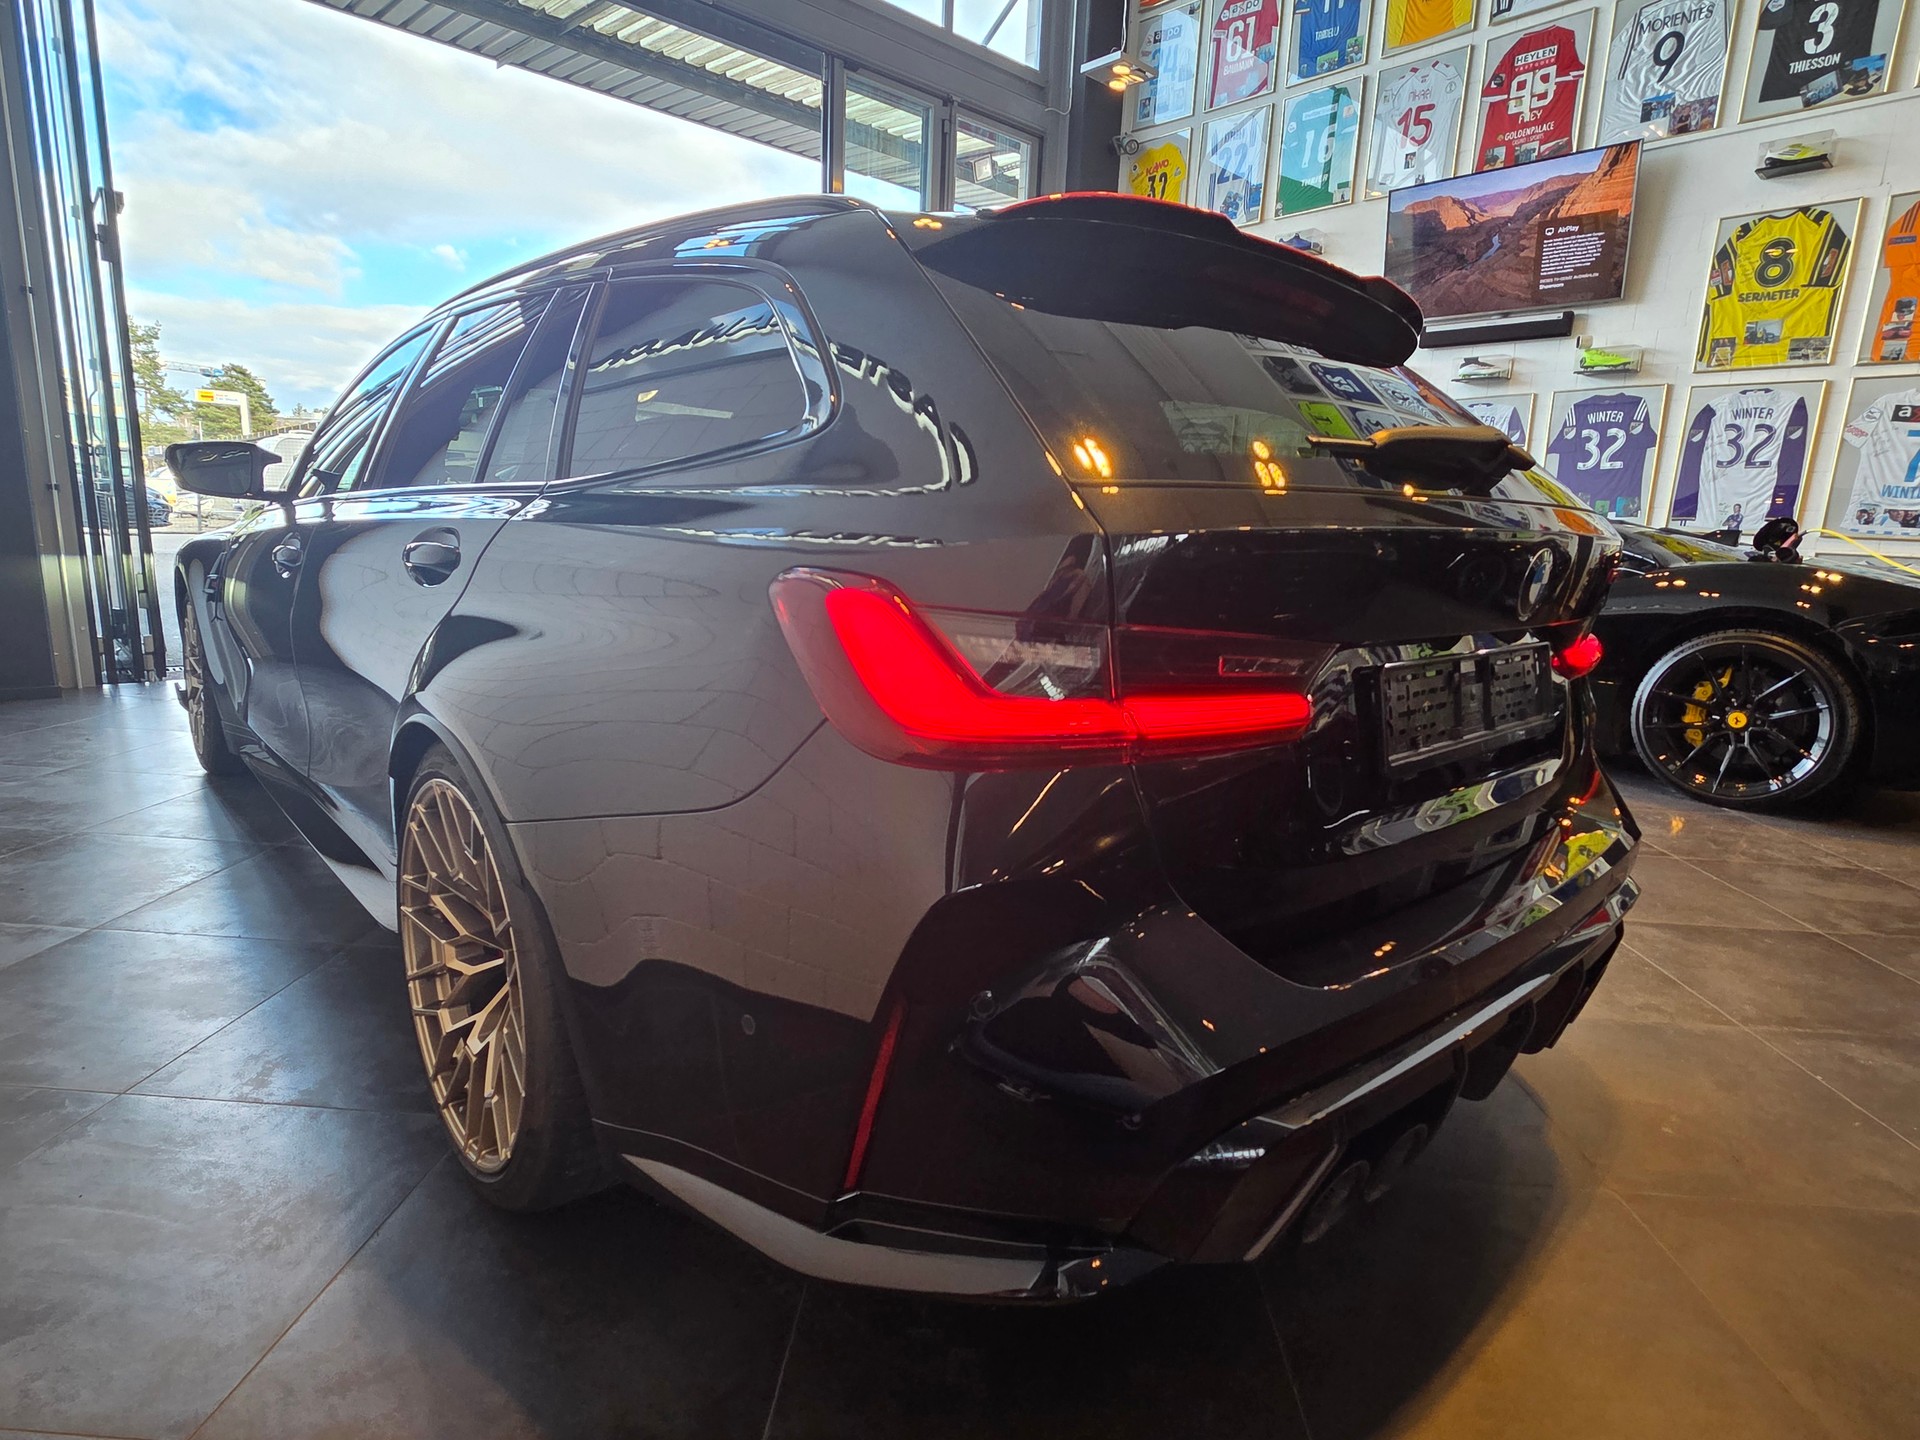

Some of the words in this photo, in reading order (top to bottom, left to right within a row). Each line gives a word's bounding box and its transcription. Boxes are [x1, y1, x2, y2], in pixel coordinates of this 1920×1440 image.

[1155, 26, 1181, 41] apo
[1226, 16, 1256, 62] 61
[1639, 4, 1714, 36] MORIENTES
[1803, 2, 1839, 55] 3
[1515, 48, 1556, 65] HEYLEN
[1653, 31, 1685, 83] 9
[1789, 53, 1841, 74] THIESSON
[1508, 65, 1557, 115] 99
[1302, 124, 1336, 168] 16
[1398, 103, 1435, 149] 15
[1504, 121, 1555, 140] GOLDENPALACE
[1217, 143, 1248, 184] 22
[1558, 225, 1579, 233] AirPlay
[1754, 236, 1796, 288] 8
[1738, 288, 1800, 303] SERMETER
[1587, 411, 1624, 424] WINTER
[1732, 407, 1774, 421] WINTER
[1577, 428, 1627, 470] 32
[1716, 424, 1777, 469] 32
